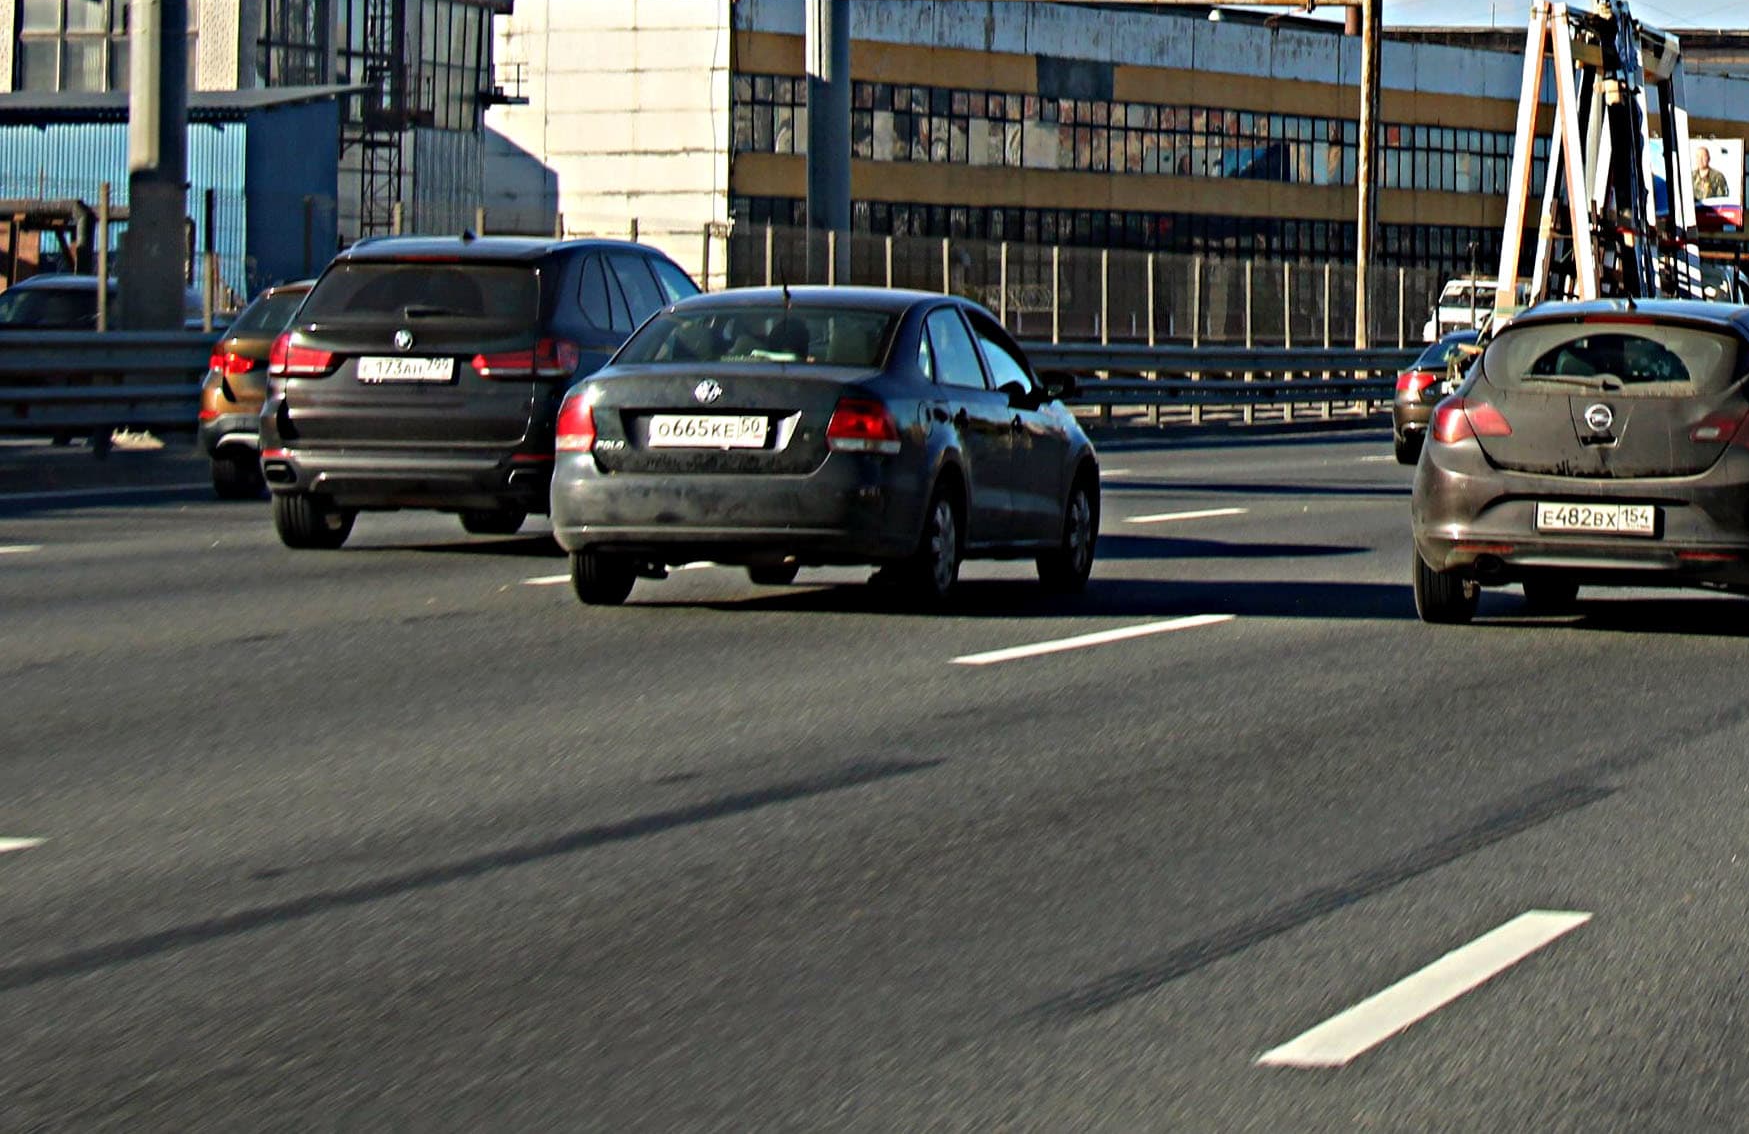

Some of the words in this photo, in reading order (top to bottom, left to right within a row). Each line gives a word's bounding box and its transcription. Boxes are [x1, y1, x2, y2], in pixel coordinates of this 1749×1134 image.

[658, 418, 734, 439] О665КЕ
[741, 417, 761, 432] 50
[595, 439, 625, 450] POLO
[1543, 506, 1617, 527] Е482ВХ
[1621, 507, 1649, 523] 154
